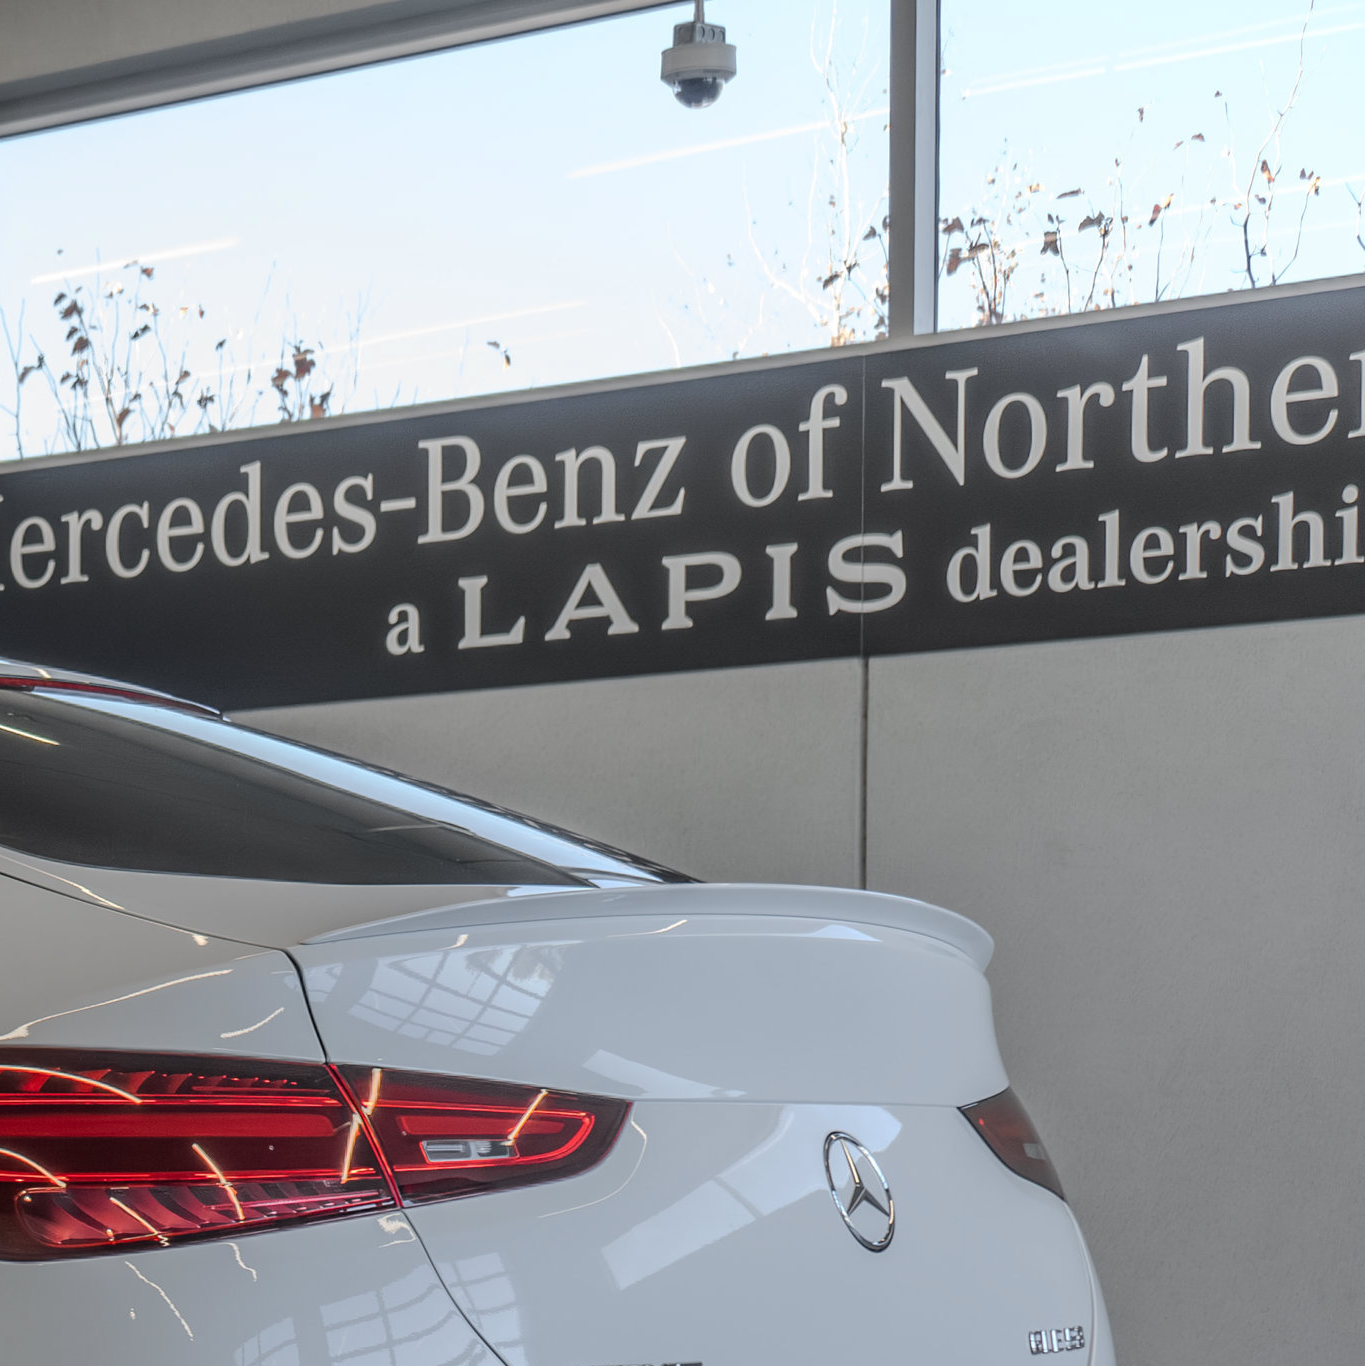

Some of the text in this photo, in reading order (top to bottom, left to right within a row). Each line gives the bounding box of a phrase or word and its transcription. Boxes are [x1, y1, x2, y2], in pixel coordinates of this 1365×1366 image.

[731, 384, 847, 507] of
[386, 604, 424, 655] a
[457, 532, 906, 649] LAPIS
